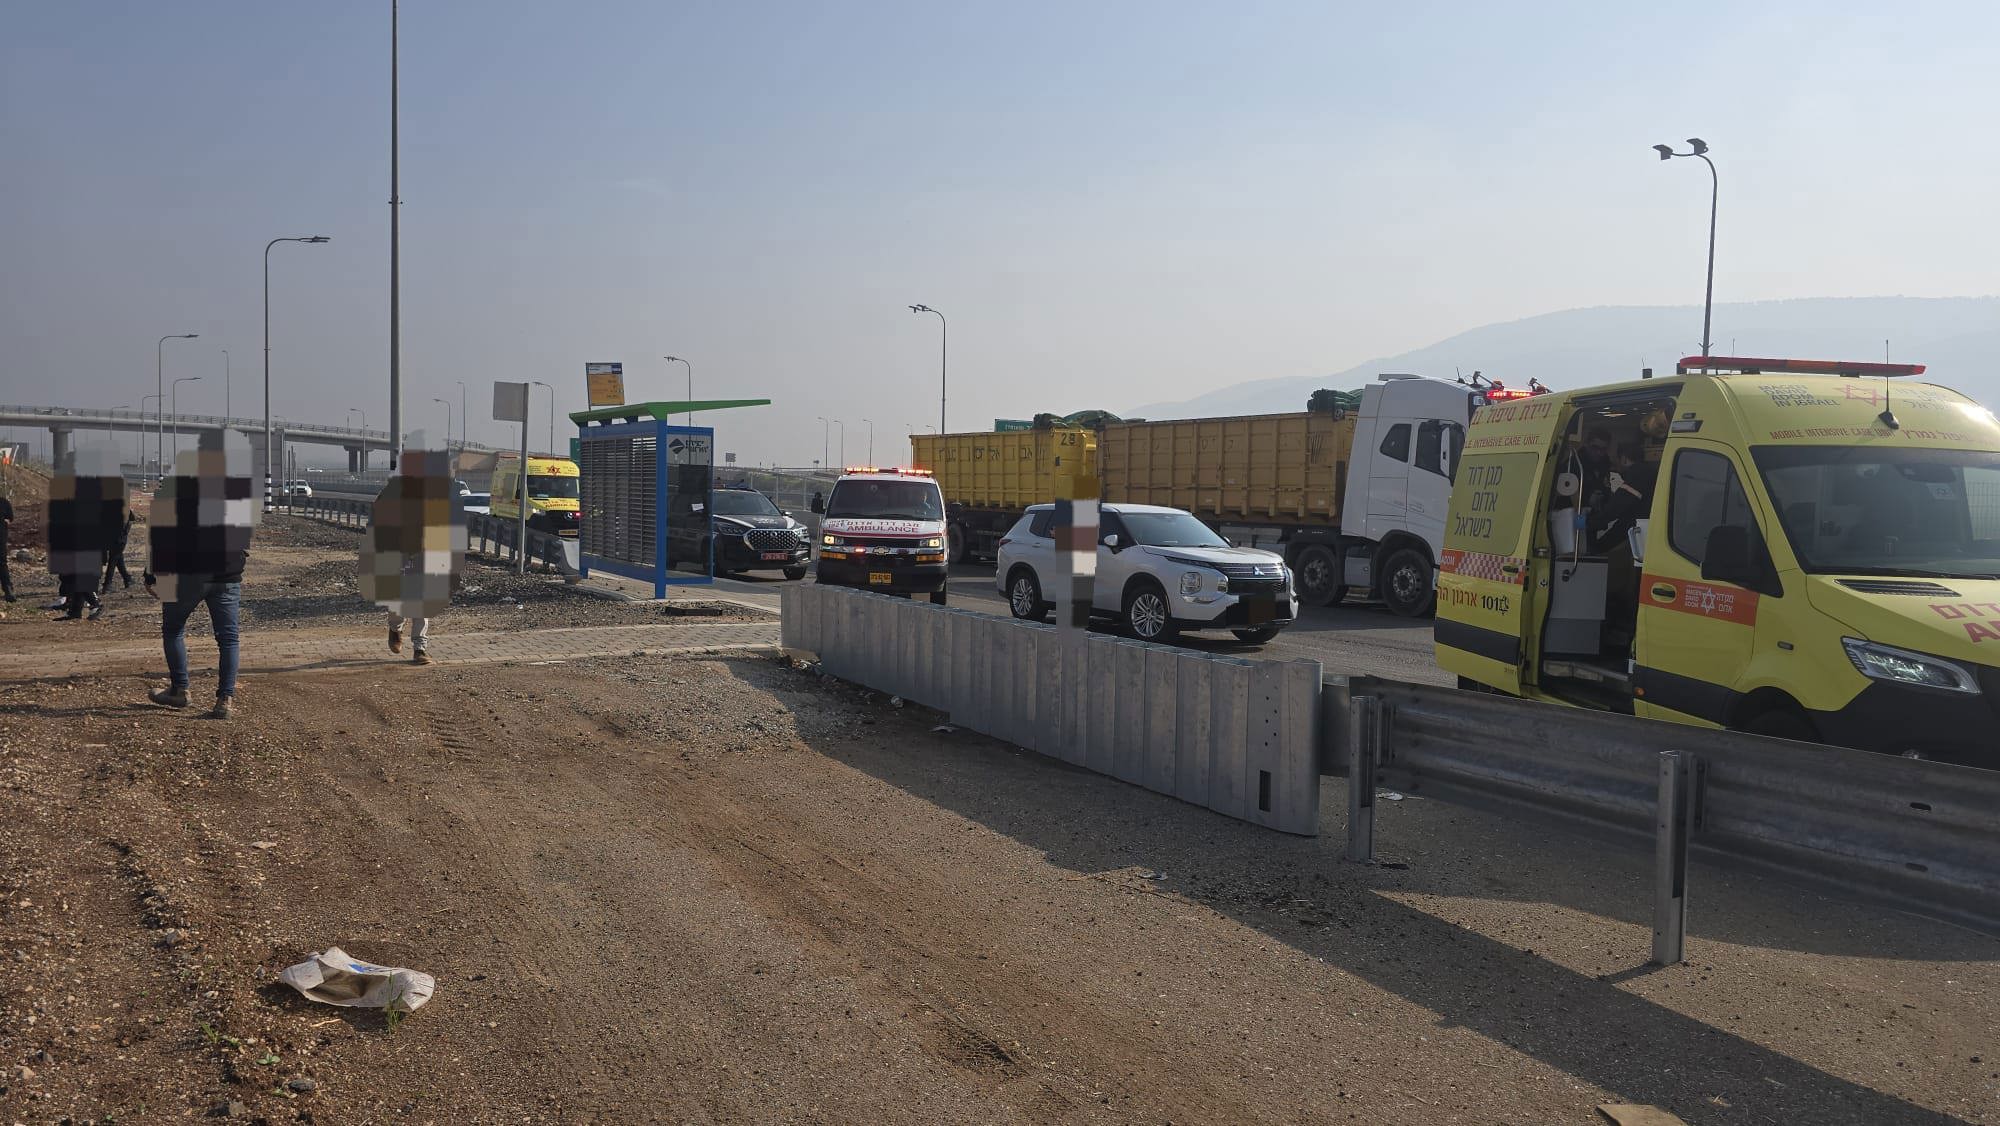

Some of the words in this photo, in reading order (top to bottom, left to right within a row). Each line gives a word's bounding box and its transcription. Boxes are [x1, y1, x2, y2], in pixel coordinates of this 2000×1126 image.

[1770, 393, 1816, 401] ADOM
[1775, 400, 1792, 408] IN
[1794, 399, 1841, 407] ISRAEL
[1487, 405, 1518, 424] טיפול
[1519, 402, 1553, 421] ניידת
[1473, 438, 1504, 449] INTENSIVE
[1505, 436, 1521, 447] CARE
[1523, 435, 1541, 446] UNIT
[1769, 430, 1804, 440] MOBILE
[1805, 428, 1849, 438] INTENSIVE
[1469, 466, 1485, 486] דוד
[1484, 466, 1503, 489] מגן
[1472, 491, 1499, 512] אדום
[846, 525, 919, 533] AMBULANCE
[1454, 512, 1492, 538] בישראל
[1451, 588, 1478, 608] ארגון
[1480, 595, 1499, 611] 101
